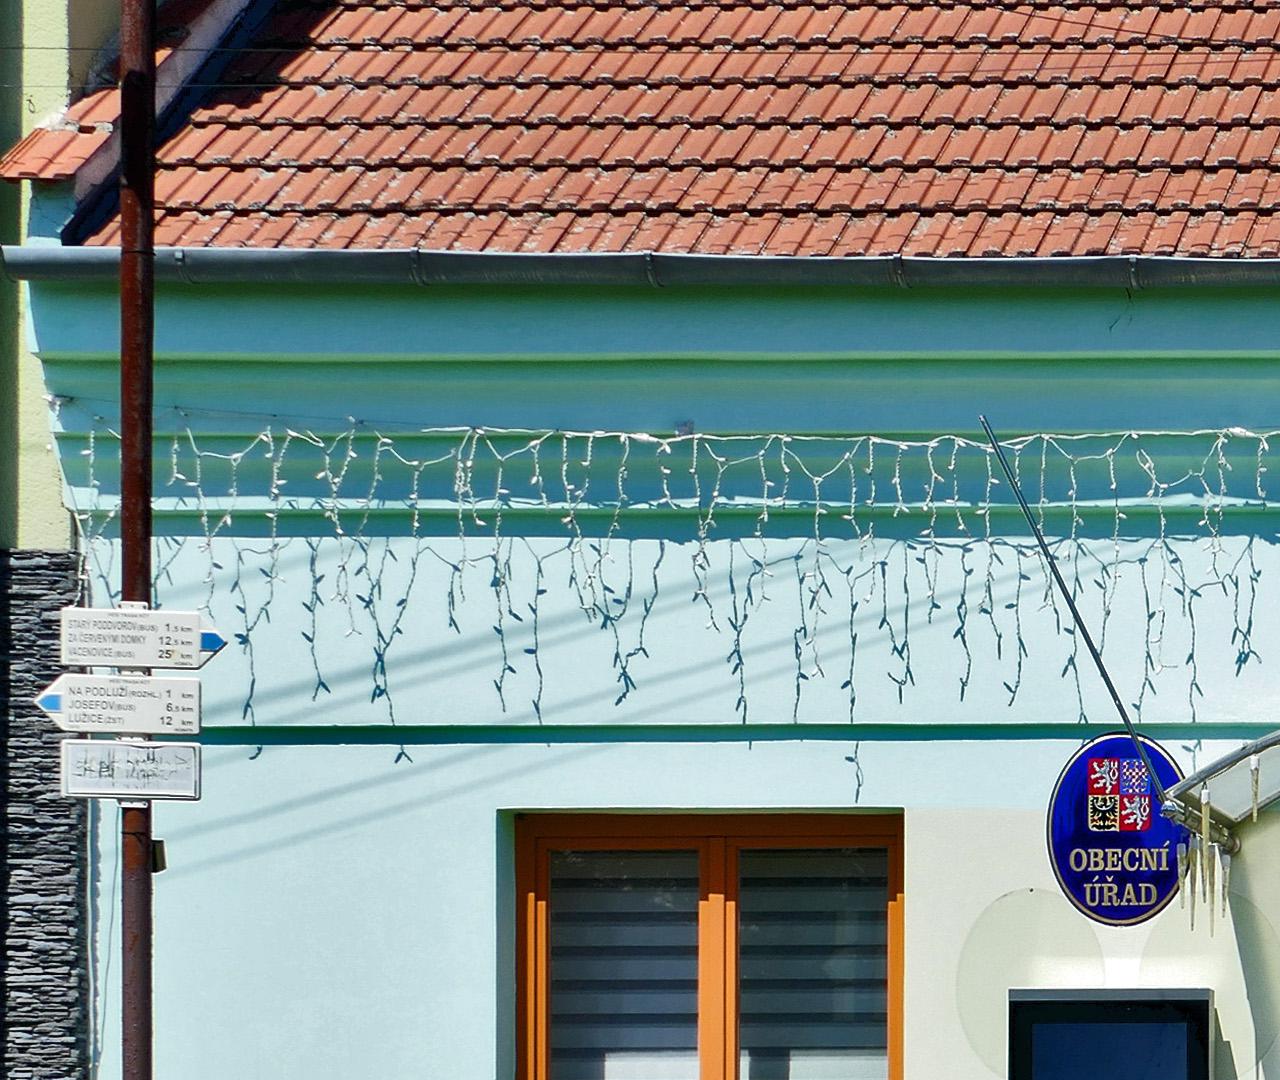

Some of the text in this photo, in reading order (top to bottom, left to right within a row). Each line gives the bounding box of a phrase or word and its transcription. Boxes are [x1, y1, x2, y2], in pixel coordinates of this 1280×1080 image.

[68, 687, 83, 695] NA
[160, 716, 173, 725] 12
[1069, 840, 1169, 872] OBECNÍ
[1083, 875, 1158, 907] ÚŘAD
